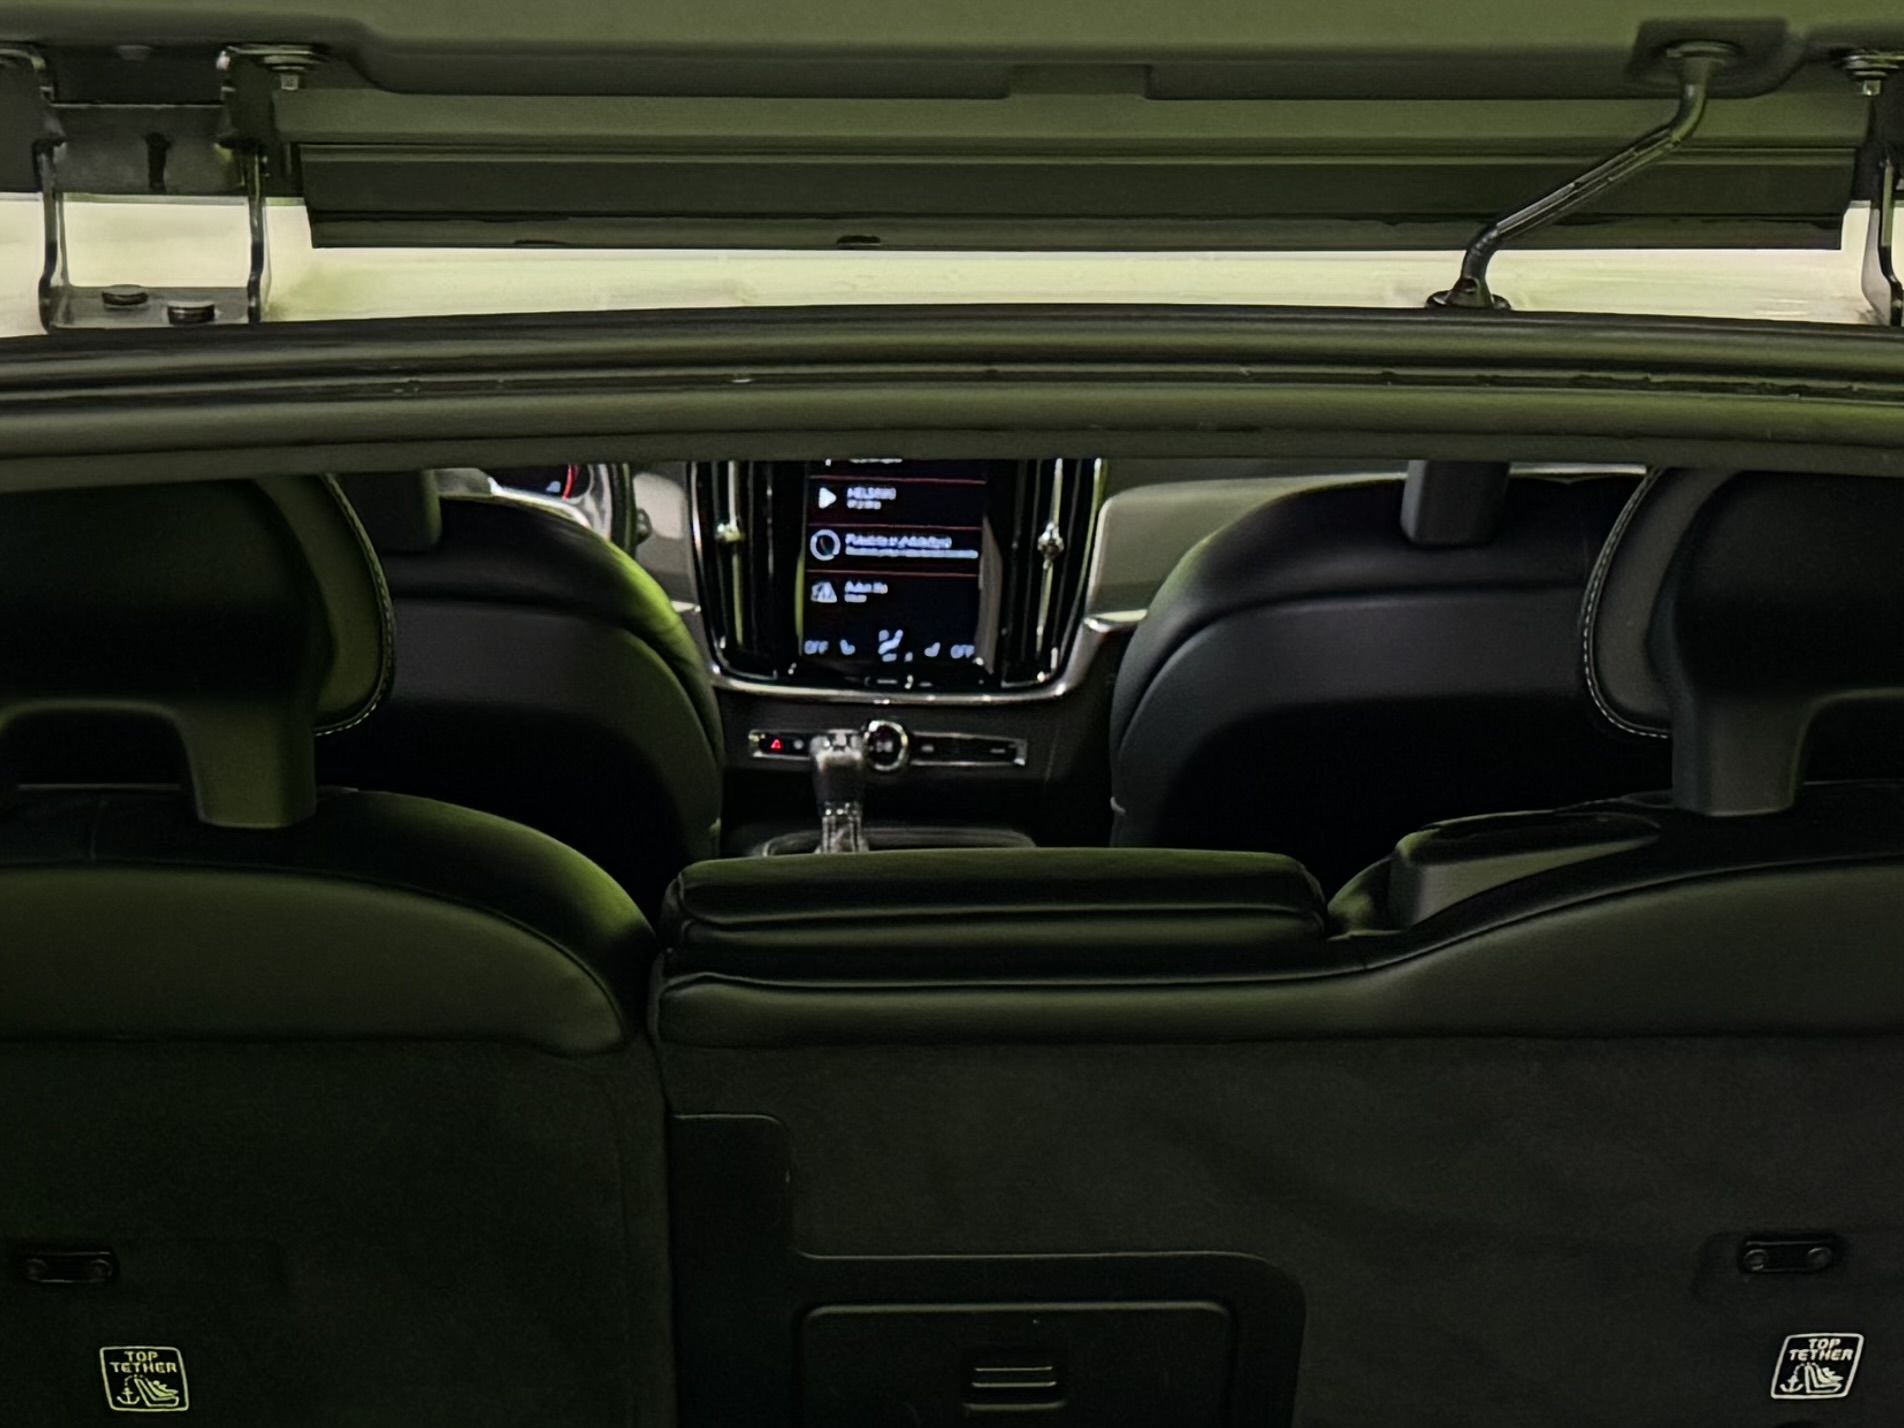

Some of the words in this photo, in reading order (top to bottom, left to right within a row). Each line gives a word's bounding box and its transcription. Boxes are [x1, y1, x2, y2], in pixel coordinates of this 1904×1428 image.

[1808, 1338, 1842, 1350] TOP
[124, 1351, 159, 1362] TOP
[1789, 1349, 1854, 1361] TETHER
[109, 1361, 177, 1373] TETHER
